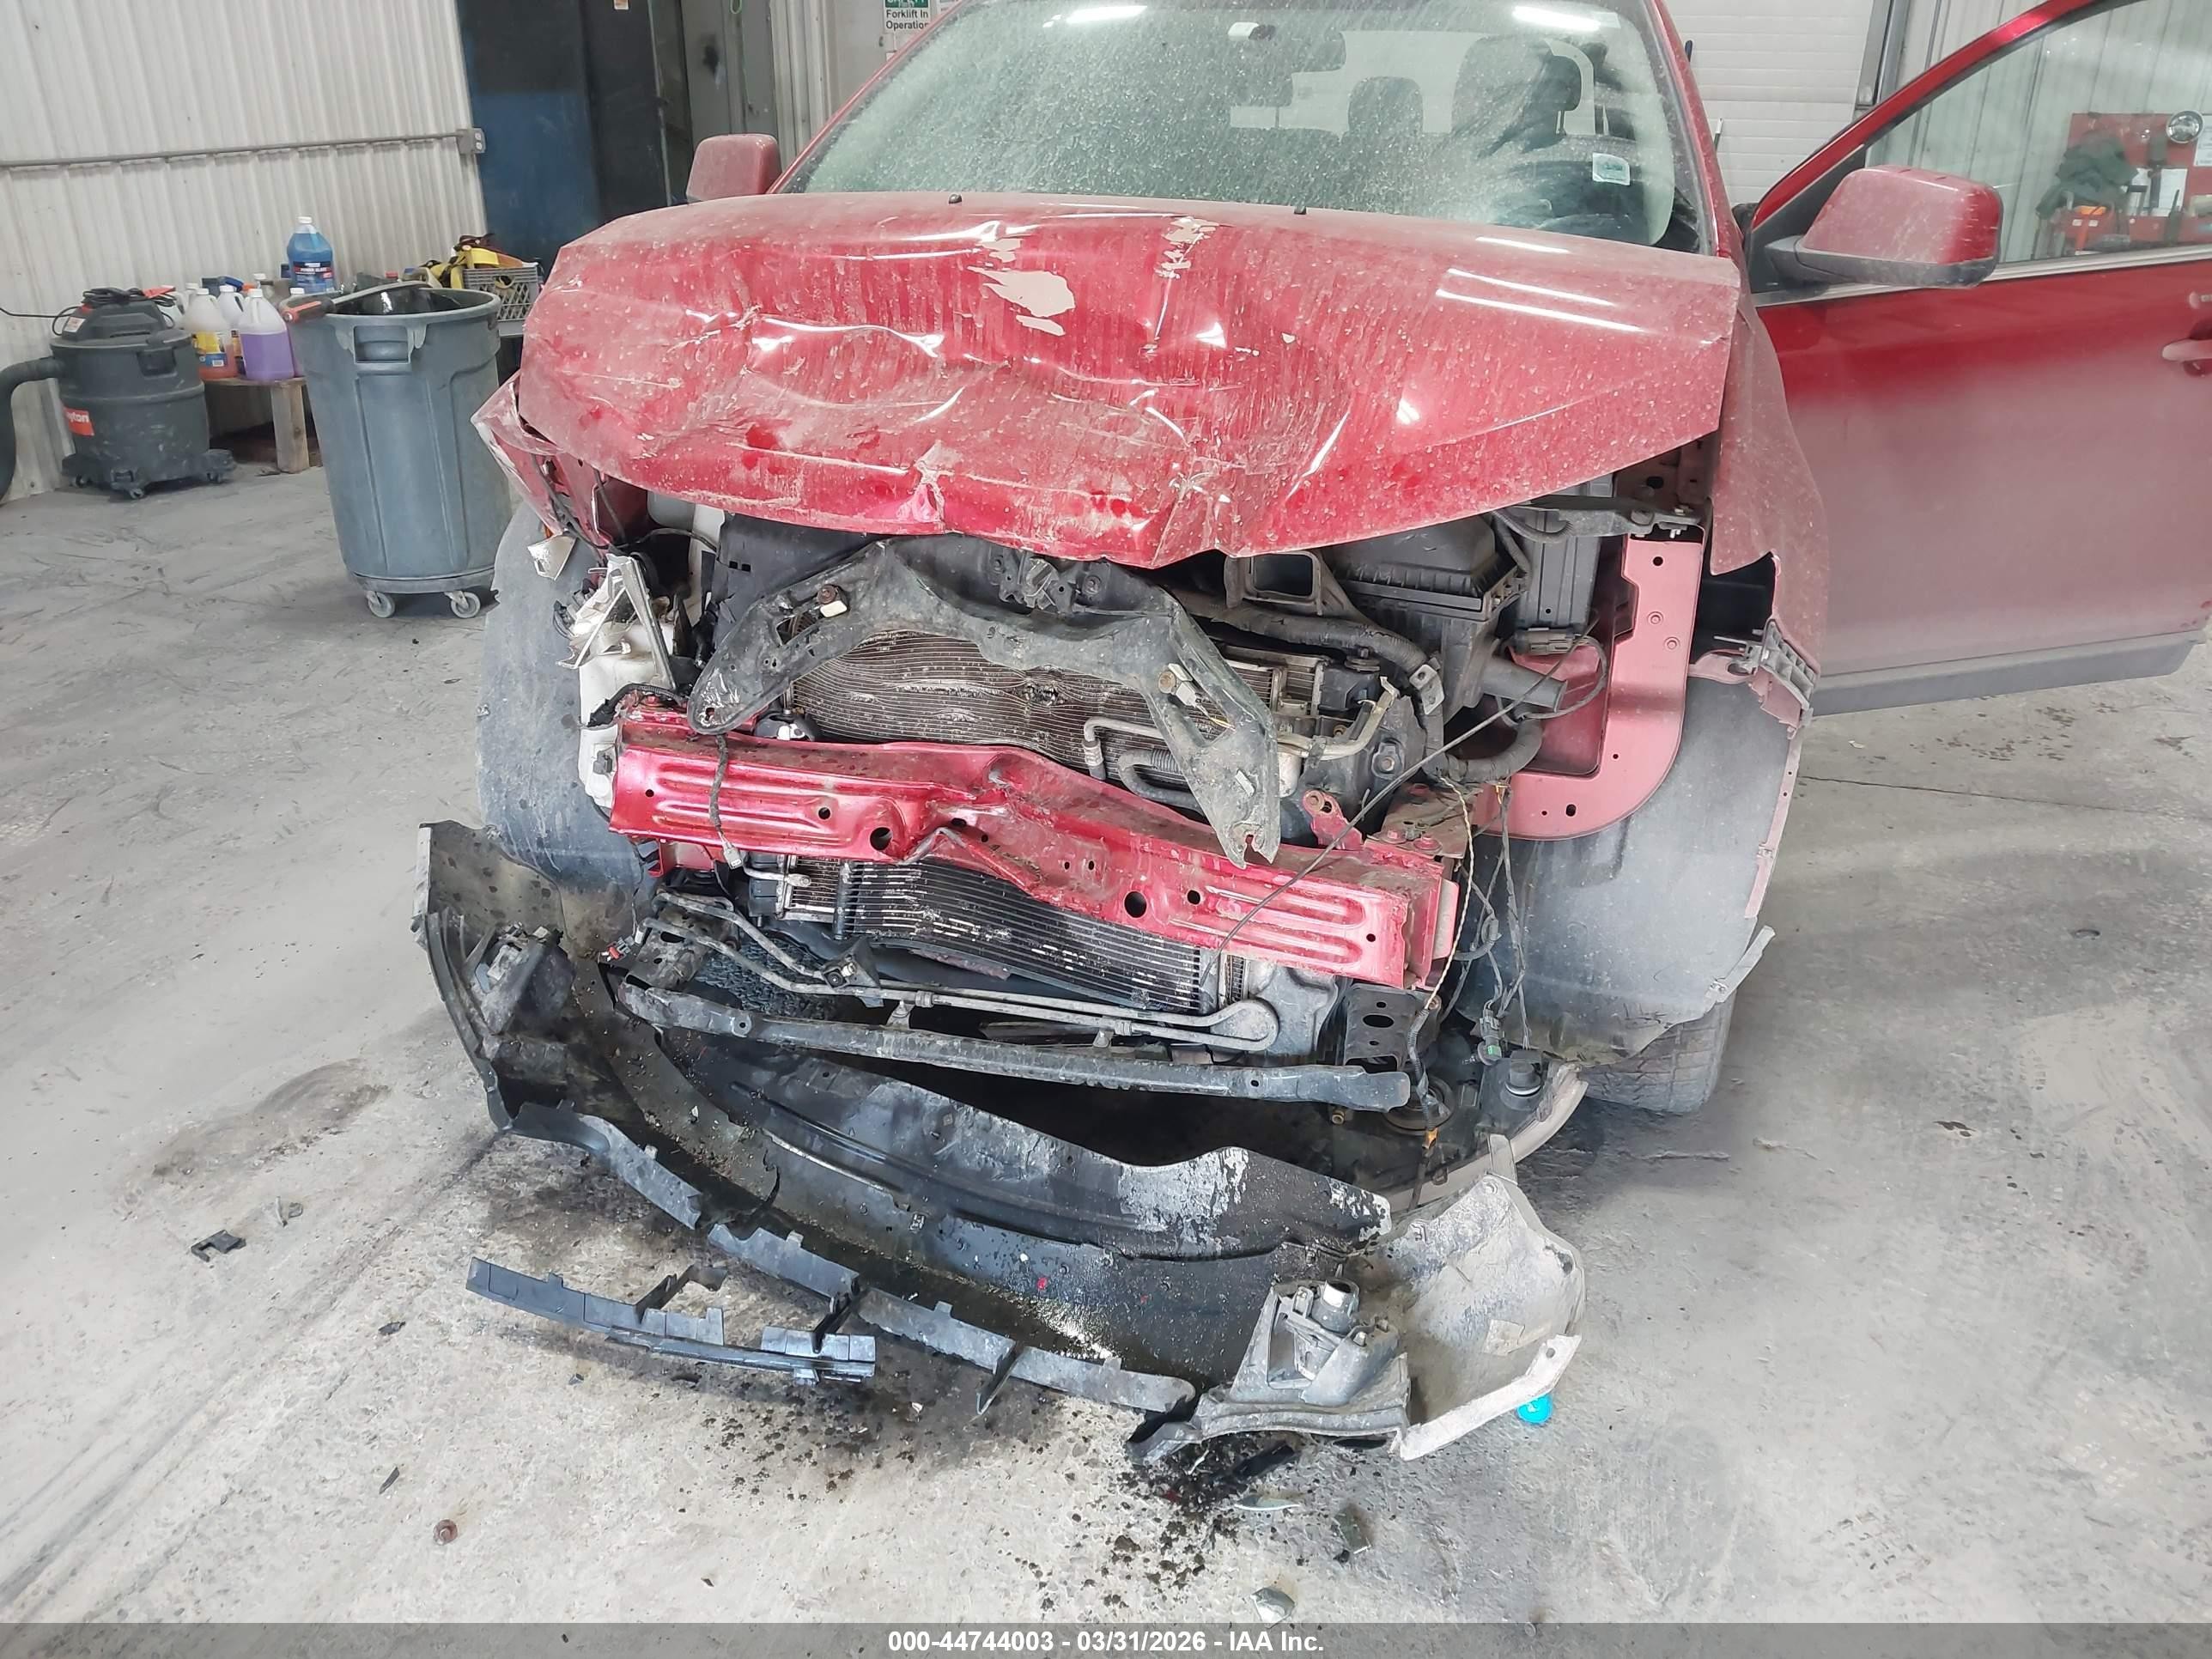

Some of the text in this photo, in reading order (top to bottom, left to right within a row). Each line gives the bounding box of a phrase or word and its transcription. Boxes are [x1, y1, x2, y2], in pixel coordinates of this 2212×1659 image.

[886, 9, 928, 18] Forklift In
[67, 410, 89, 422] yton
